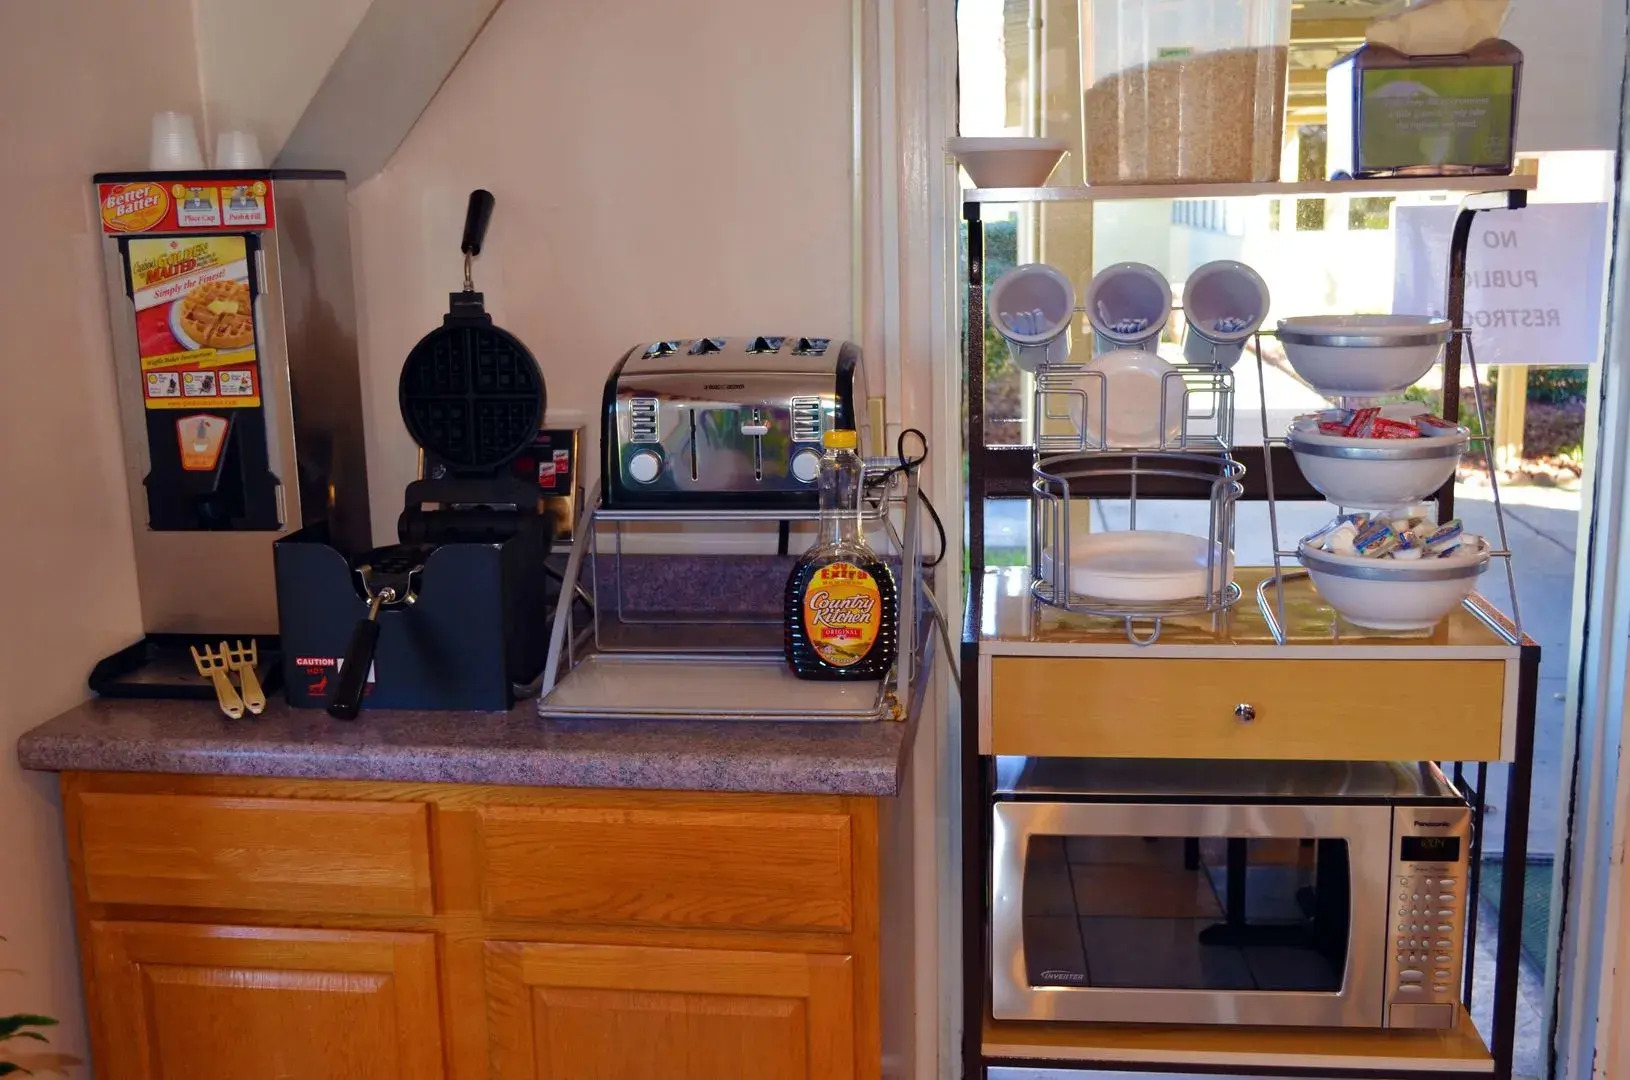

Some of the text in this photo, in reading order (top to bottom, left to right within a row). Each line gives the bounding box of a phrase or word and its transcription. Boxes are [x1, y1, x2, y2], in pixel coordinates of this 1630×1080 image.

[106, 185, 151, 209] Better
[116, 195, 158, 217] Batter
[184, 214, 216, 223] Place Cup
[157, 243, 208, 268] GOLDEN
[146, 258, 197, 284] MALTED
[154, 269, 226, 299] Simply the Finest!
[810, 591, 875, 613] Country
[813, 606, 872, 629] Kitchen
[296, 658, 334, 666] CAUTION
